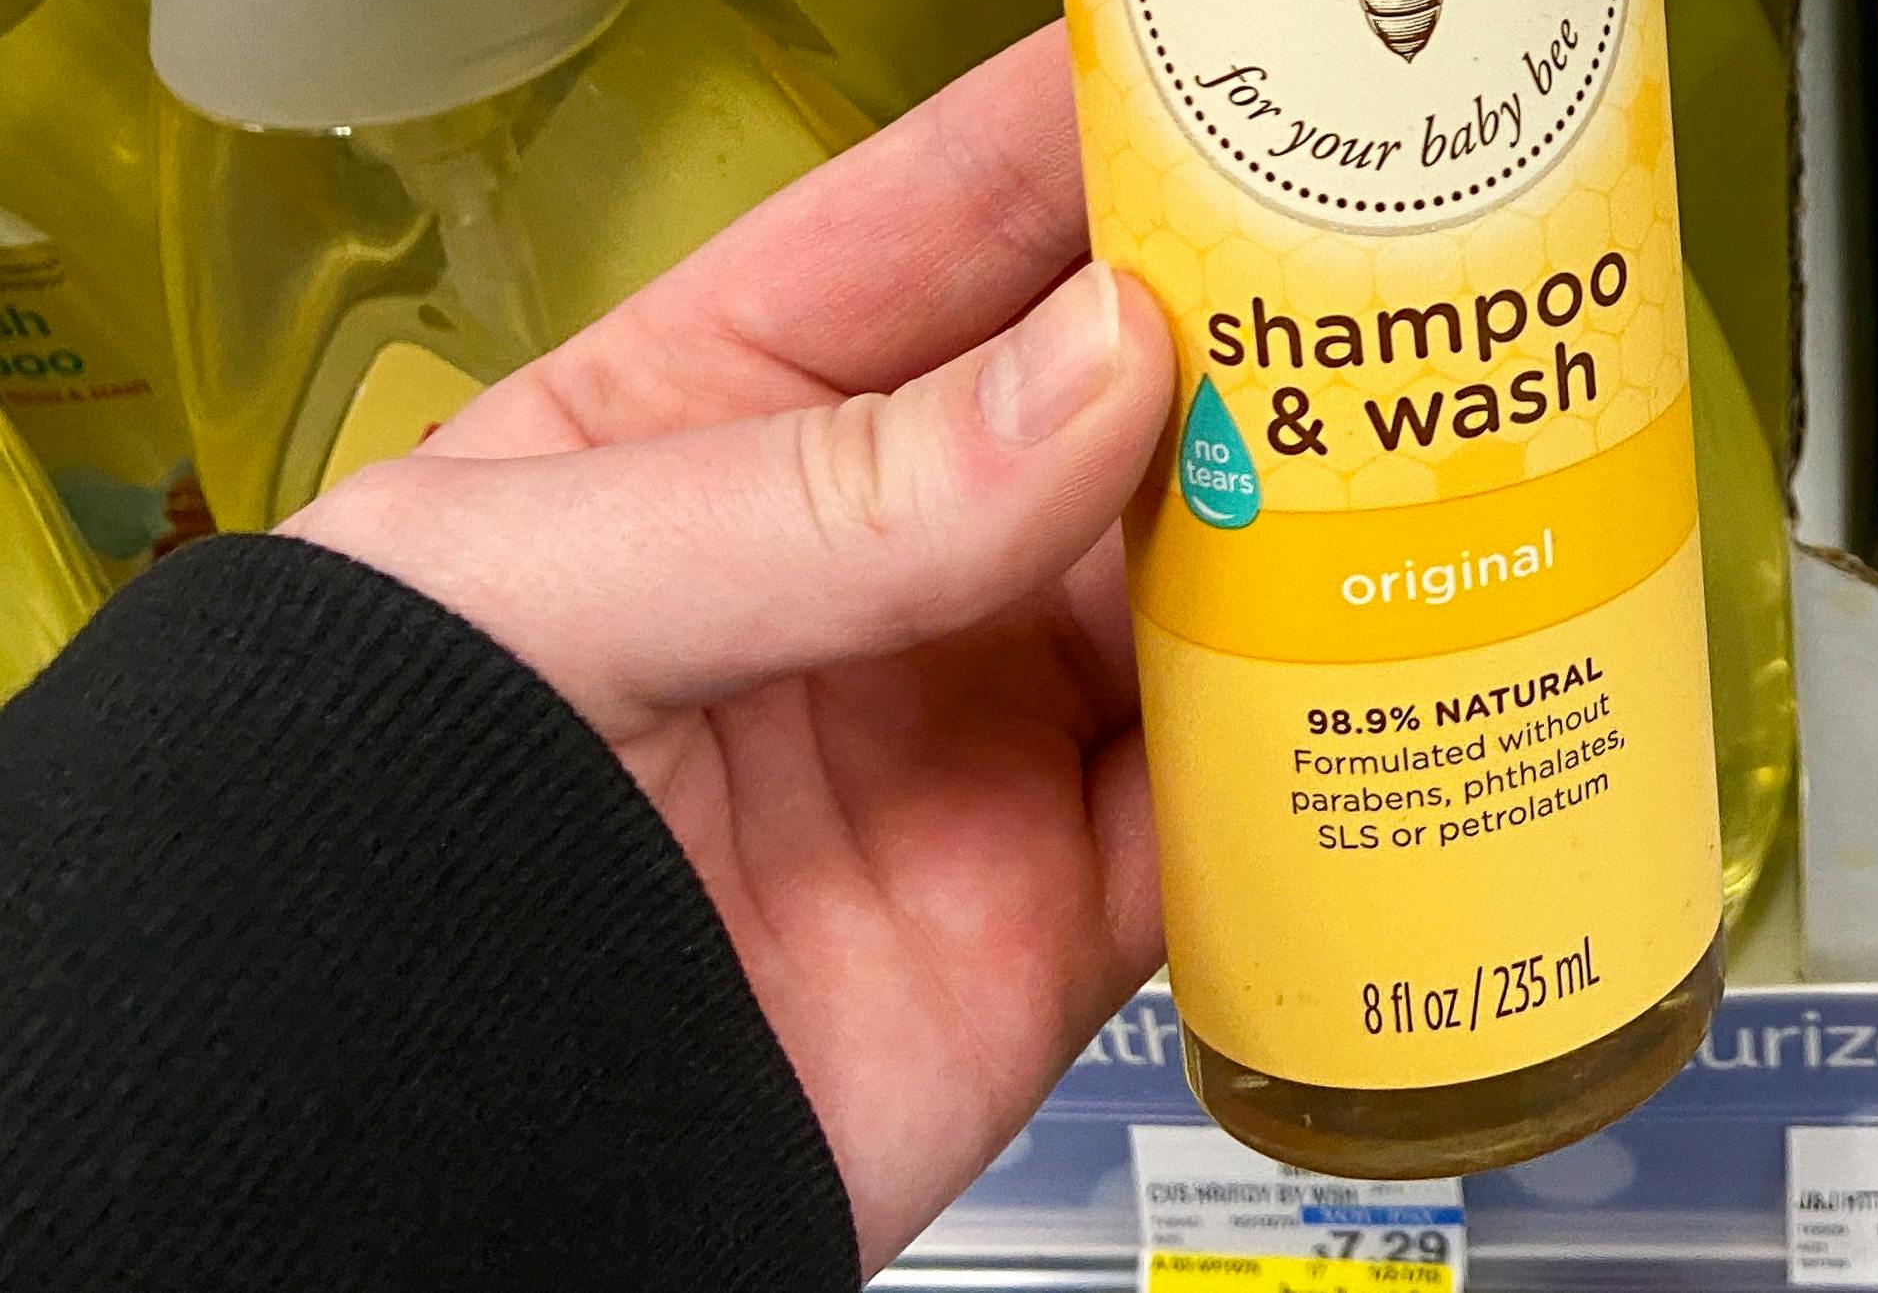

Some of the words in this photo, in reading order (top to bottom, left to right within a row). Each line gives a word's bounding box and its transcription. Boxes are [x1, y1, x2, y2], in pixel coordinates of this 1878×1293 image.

[1196, 62, 1281, 122] for
[1268, 114, 1402, 171] your
[1420, 92, 1522, 167] baby
[1522, 16, 1579, 96] bee
[1208, 251, 1627, 369] shampoo
[1267, 386, 1329, 456] &
[1365, 342, 1596, 452] wash
[1186, 461, 1254, 494] tears
[1194, 437, 1229, 464] no
[1341, 528, 1554, 606] original
[1293, 735, 1486, 775] Formulated
[1498, 692, 1610, 753] without
[1307, 705, 1421, 735] 98.9%
[1436, 657, 1604, 727] NATURAL
[1291, 787, 1452, 814] parabens,
[1464, 726, 1626, 805] phthalates,
[1318, 824, 1379, 849] SLS
[1392, 822, 1427, 849] or
[1439, 771, 1610, 847] petrolatum
[1363, 982, 1383, 1035] 8
[1390, 980, 1414, 1034] fl
[1424, 985, 1461, 1031] oz
[1469, 965, 1483, 1032] /
[1493, 954, 1548, 1019] 235
[1555, 935, 1600, 1000] mL
